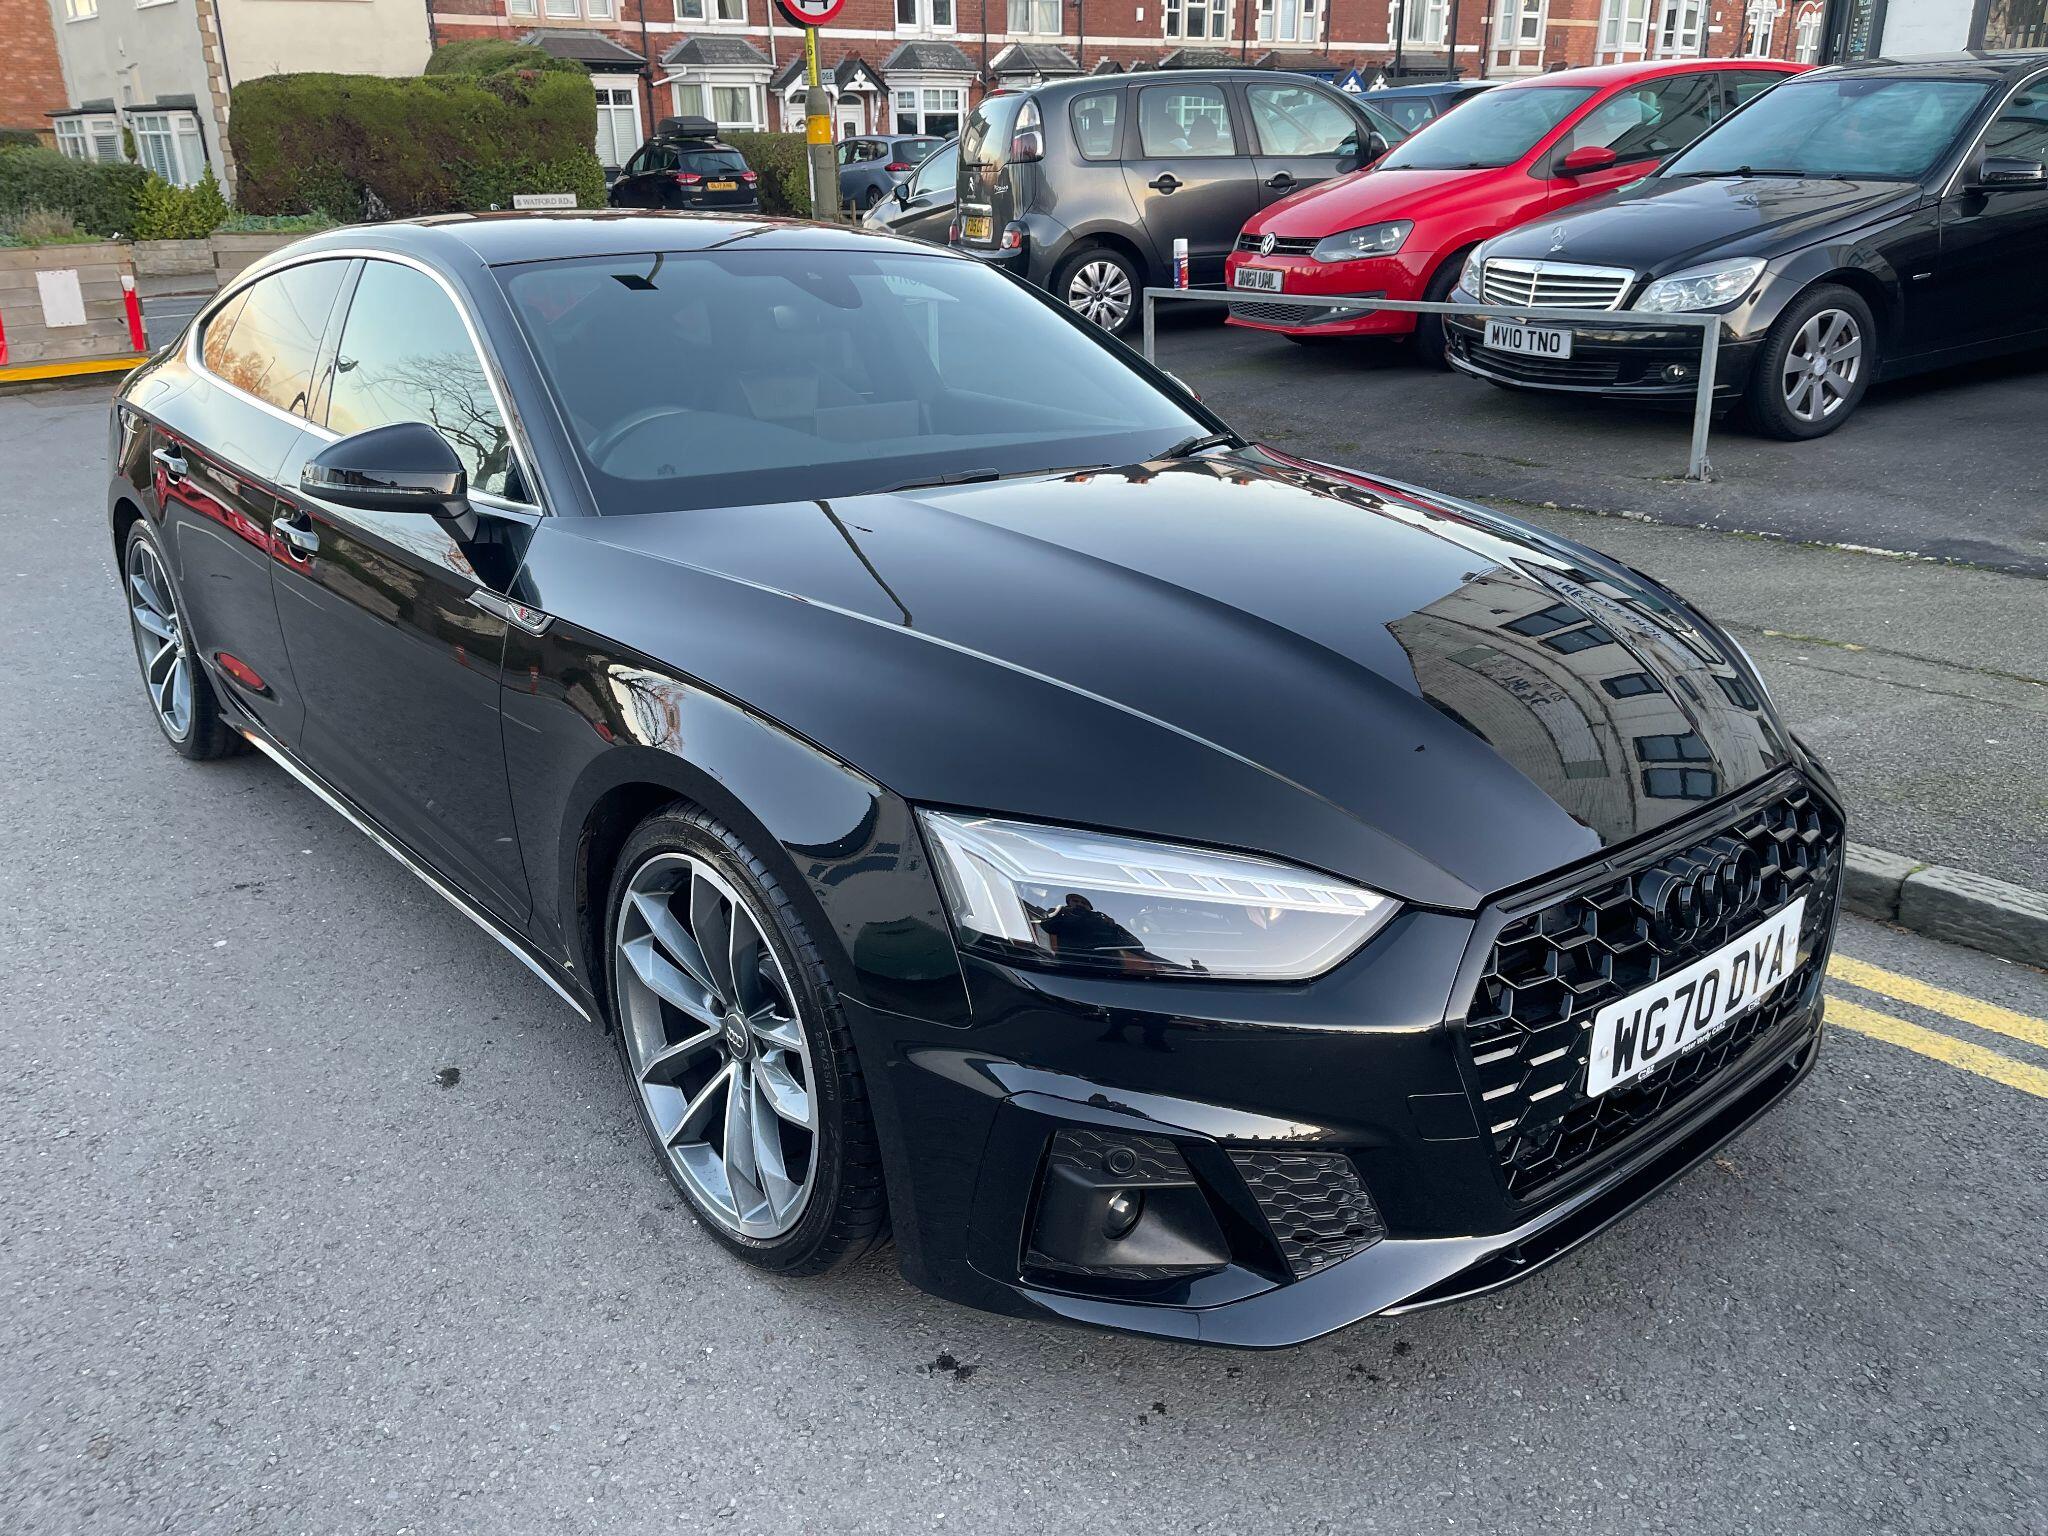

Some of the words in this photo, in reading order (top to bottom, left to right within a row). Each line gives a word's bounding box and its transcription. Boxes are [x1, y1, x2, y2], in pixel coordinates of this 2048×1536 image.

[522, 198, 557, 206] WATFORD
[558, 197, 569, 205] RD
[1492, 325, 1522, 348] MV10
[1527, 330, 1560, 353] TNO
[1611, 968, 1720, 1079] WG70
[1724, 924, 1786, 1014] DYA
